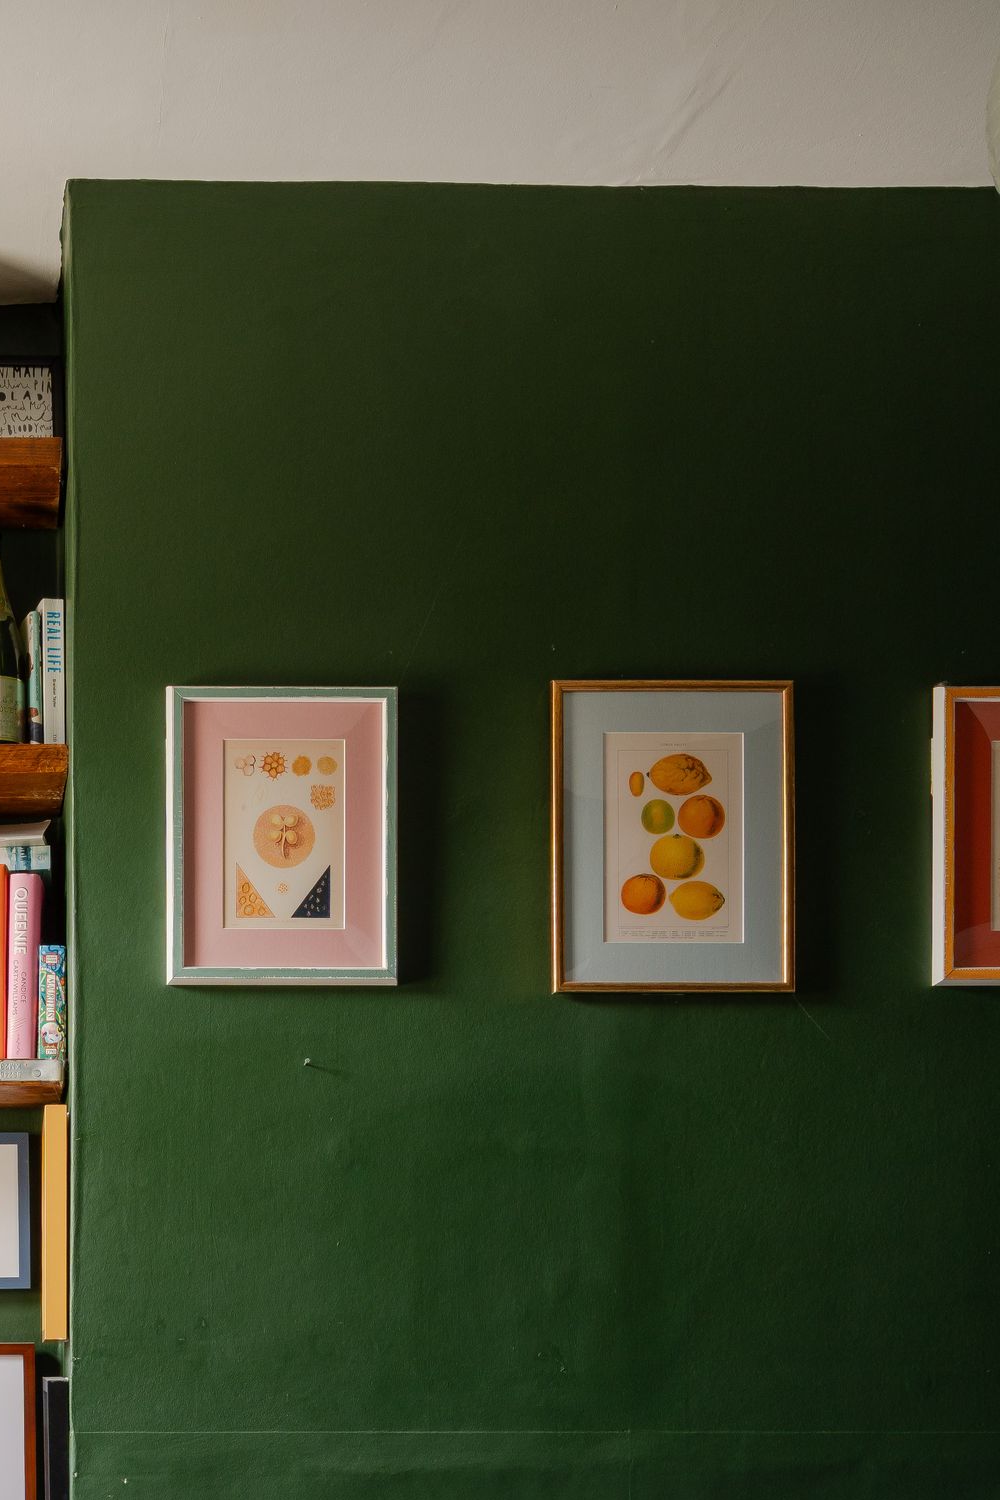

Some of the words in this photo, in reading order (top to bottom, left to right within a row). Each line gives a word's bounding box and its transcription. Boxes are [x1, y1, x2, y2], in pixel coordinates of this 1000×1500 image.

[47, 611, 60, 642] REAL
[48, 648, 61, 672] LIFE
[14, 886, 29, 955] QUEENIE
